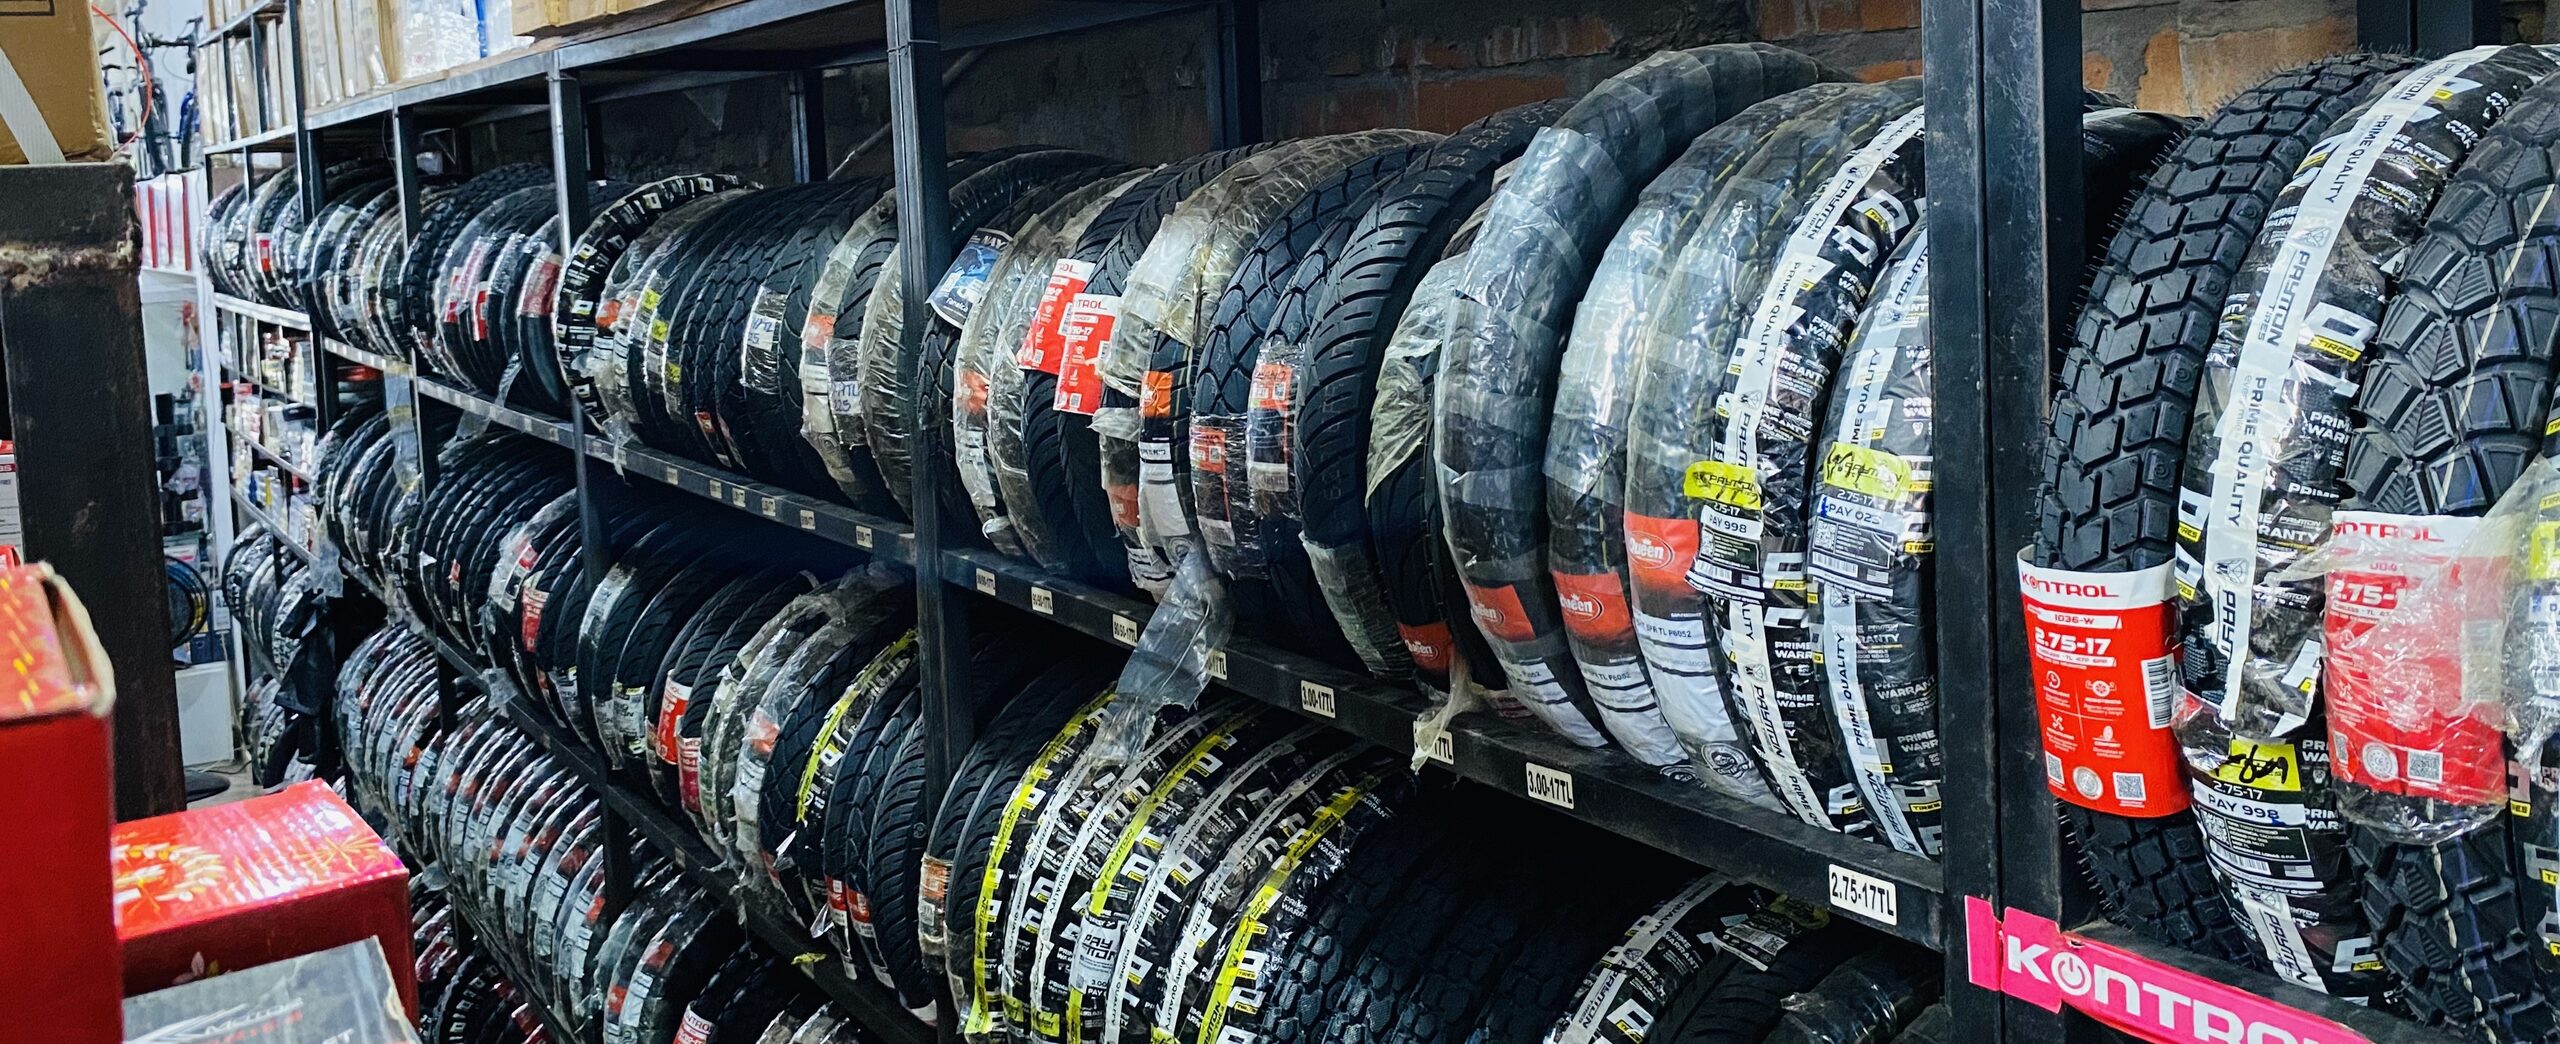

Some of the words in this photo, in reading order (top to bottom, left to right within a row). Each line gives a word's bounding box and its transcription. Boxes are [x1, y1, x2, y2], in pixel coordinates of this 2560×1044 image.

[2359, 114, 2394, 146] PRIME
[2324, 149, 2365, 204] QUALITY
[1807, 179, 1855, 241] PAYTON
[2266, 250, 2311, 347] PAYTON
[1756, 304, 1781, 367] QUALITY
[2257, 303, 2275, 341] TIRES
[1857, 348, 1881, 414] QUALITY
[2244, 376, 2268, 437] PRIME
[2228, 441, 2254, 527] QUALITY
[1724, 520, 1748, 535] 998
[1829, 503, 1853, 518] PAY
[2257, 526, 2319, 544] RANTY
[2034, 626, 2112, 656] 2.75-17
[1837, 632, 1853, 701] QUALITY
[1302, 685, 1335, 714] 3.00-17TL
[1776, 690, 1815, 703] PRIME
[1753, 684, 1786, 760] PAYTON
[1847, 702, 1866, 748] PRIME
[1897, 729, 1937, 744] PRIME
[1901, 739, 1940, 753] WARR
[1527, 770, 1573, 805] 3.00-17TL
[1788, 775, 1813, 811] PRIME
[2213, 780, 2263, 801] 2.75-17
[2208, 793, 2238, 813] PAY
[2242, 804, 2281, 821] 998
[1049, 873, 1067, 914] QUALITY
[1831, 871, 1895, 917] 2.75-17TL
[2006, 935, 2321, 1044] KONTRO
